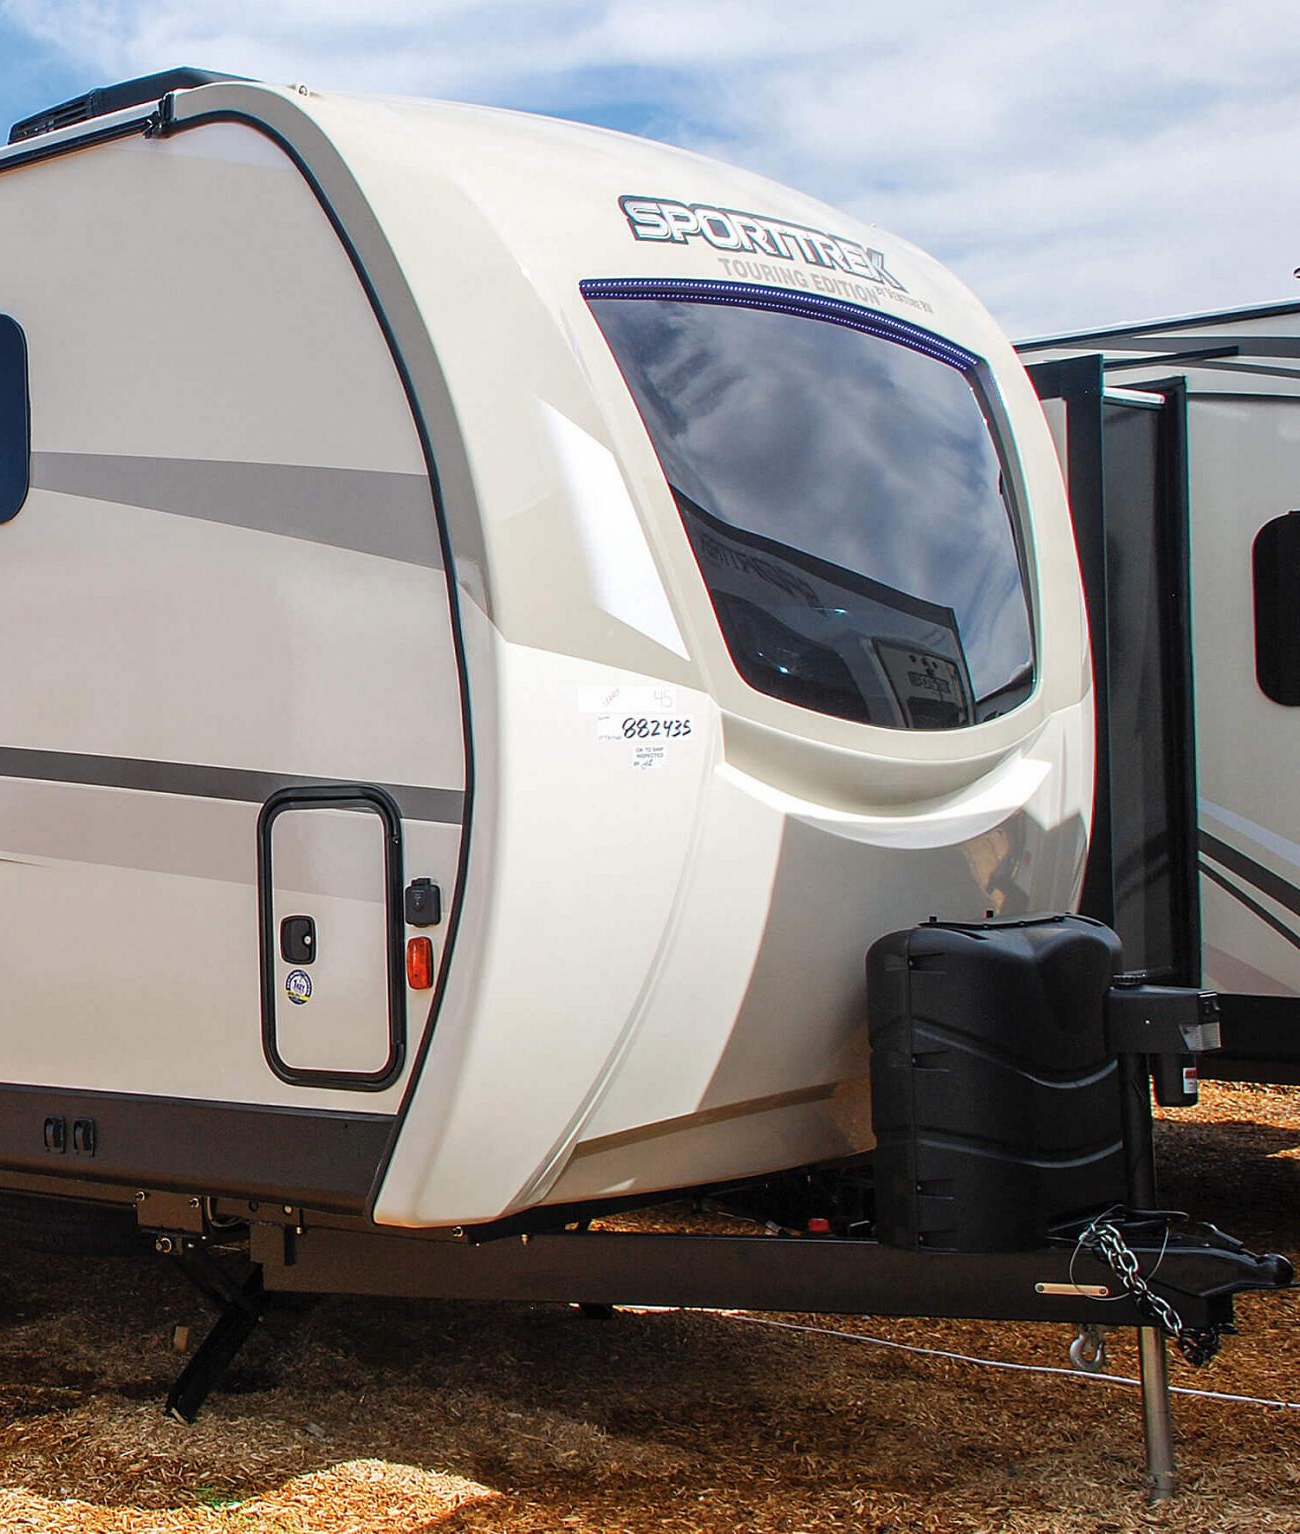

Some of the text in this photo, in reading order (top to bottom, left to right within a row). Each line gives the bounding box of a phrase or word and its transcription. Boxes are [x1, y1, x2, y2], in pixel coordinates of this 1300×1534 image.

[618, 195, 908, 292] SPORTTREK
[718, 257, 881, 306] TOURING EDITION
[621, 717, 692, 739] 882435
